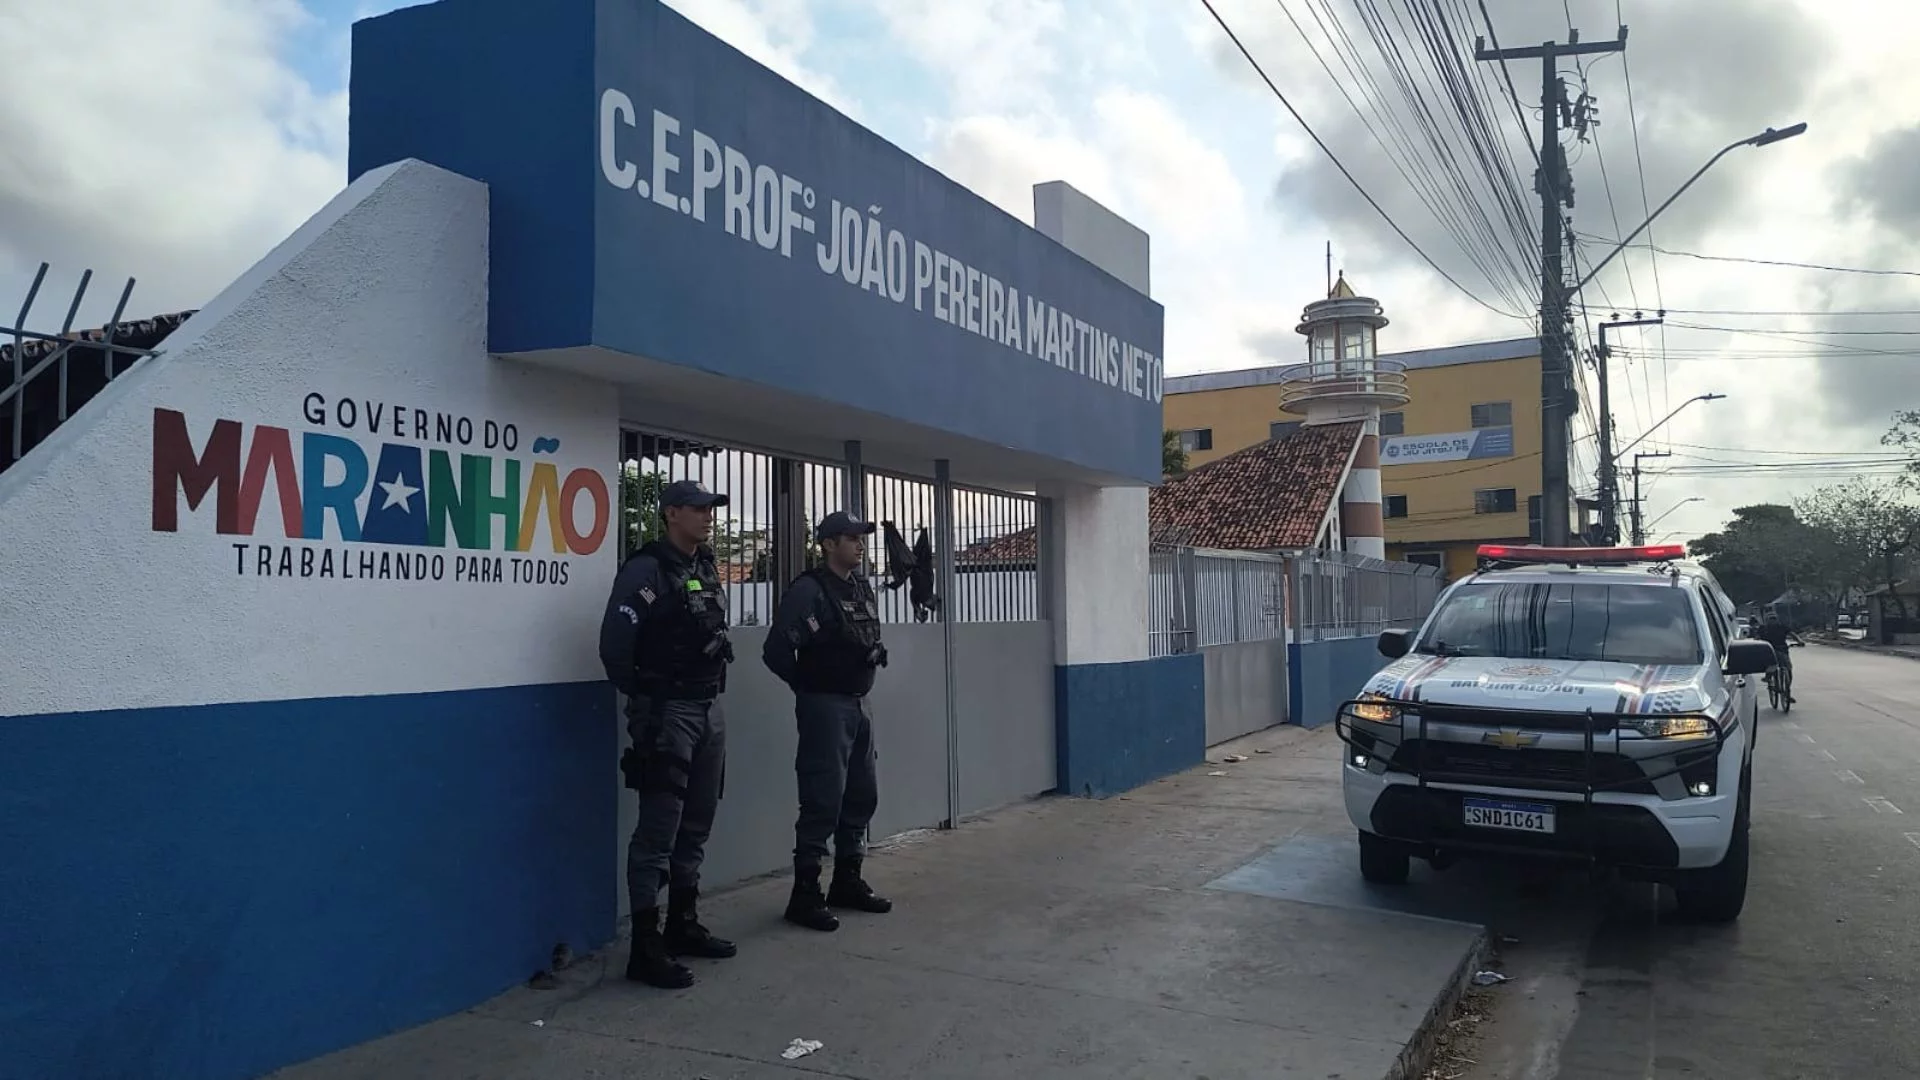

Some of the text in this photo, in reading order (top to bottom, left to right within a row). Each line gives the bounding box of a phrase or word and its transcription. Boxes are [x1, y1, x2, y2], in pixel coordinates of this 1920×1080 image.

[816, 199, 907, 303] JOÃO
[914, 240, 1022, 351] PEREIRA
[1026, 295, 1119, 387] MARTINS
[1122, 341, 1163, 405] NETO
[303, 392, 519, 452] GOVERNO DO
[1403, 439, 1468, 450] ESCOLA DE
[1422, 446, 1452, 455] JITSU
[152, 407, 610, 556] MARANHÃO
[232, 543, 570, 586] TRABALHANDO PARA TODOS
[1472, 807, 1545, 830] SND1C61
